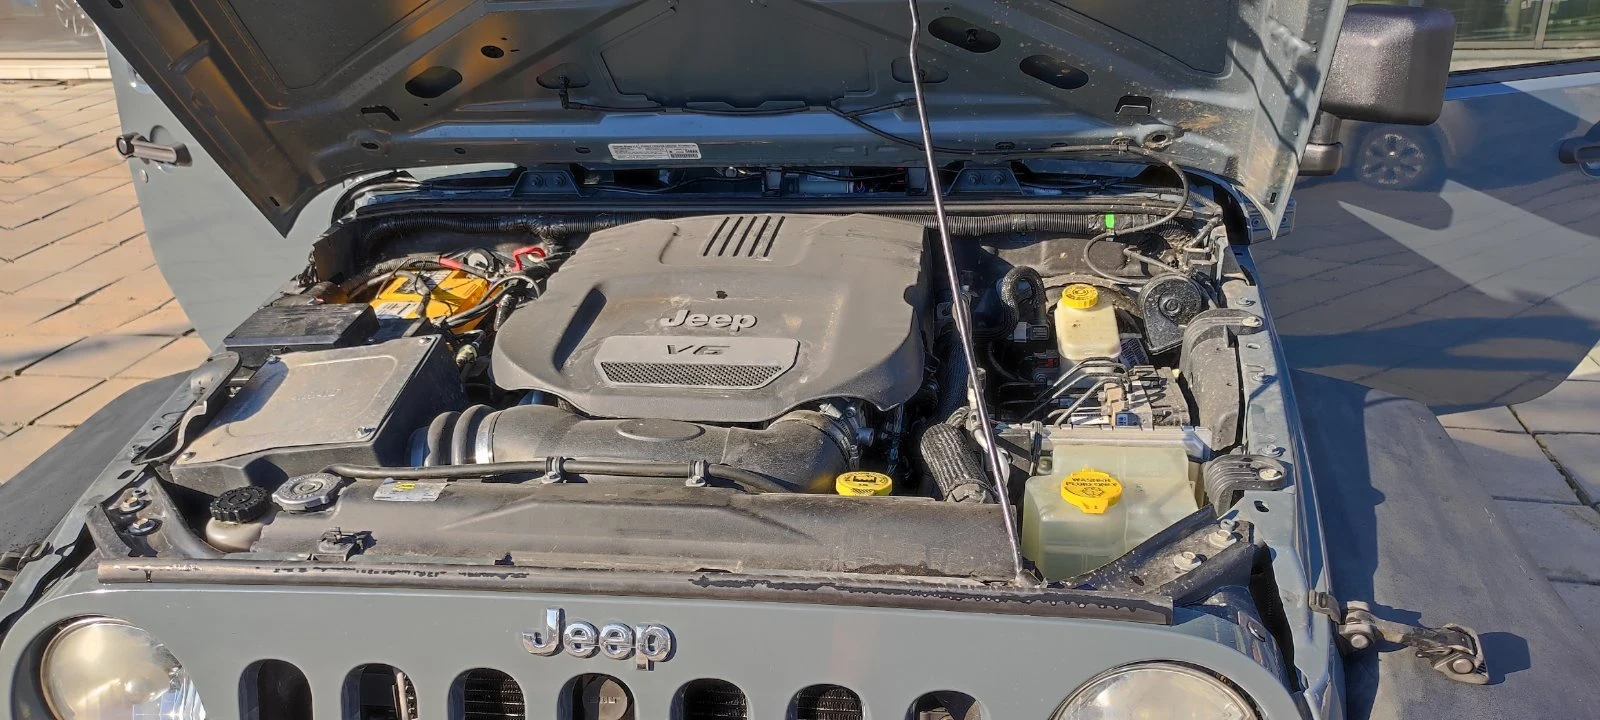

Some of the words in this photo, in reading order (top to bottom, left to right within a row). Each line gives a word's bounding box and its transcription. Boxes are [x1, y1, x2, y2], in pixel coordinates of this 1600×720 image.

[660, 309, 757, 332] Jeep
[667, 344, 731, 355] V6
[522, 607, 676, 671] Jeep
